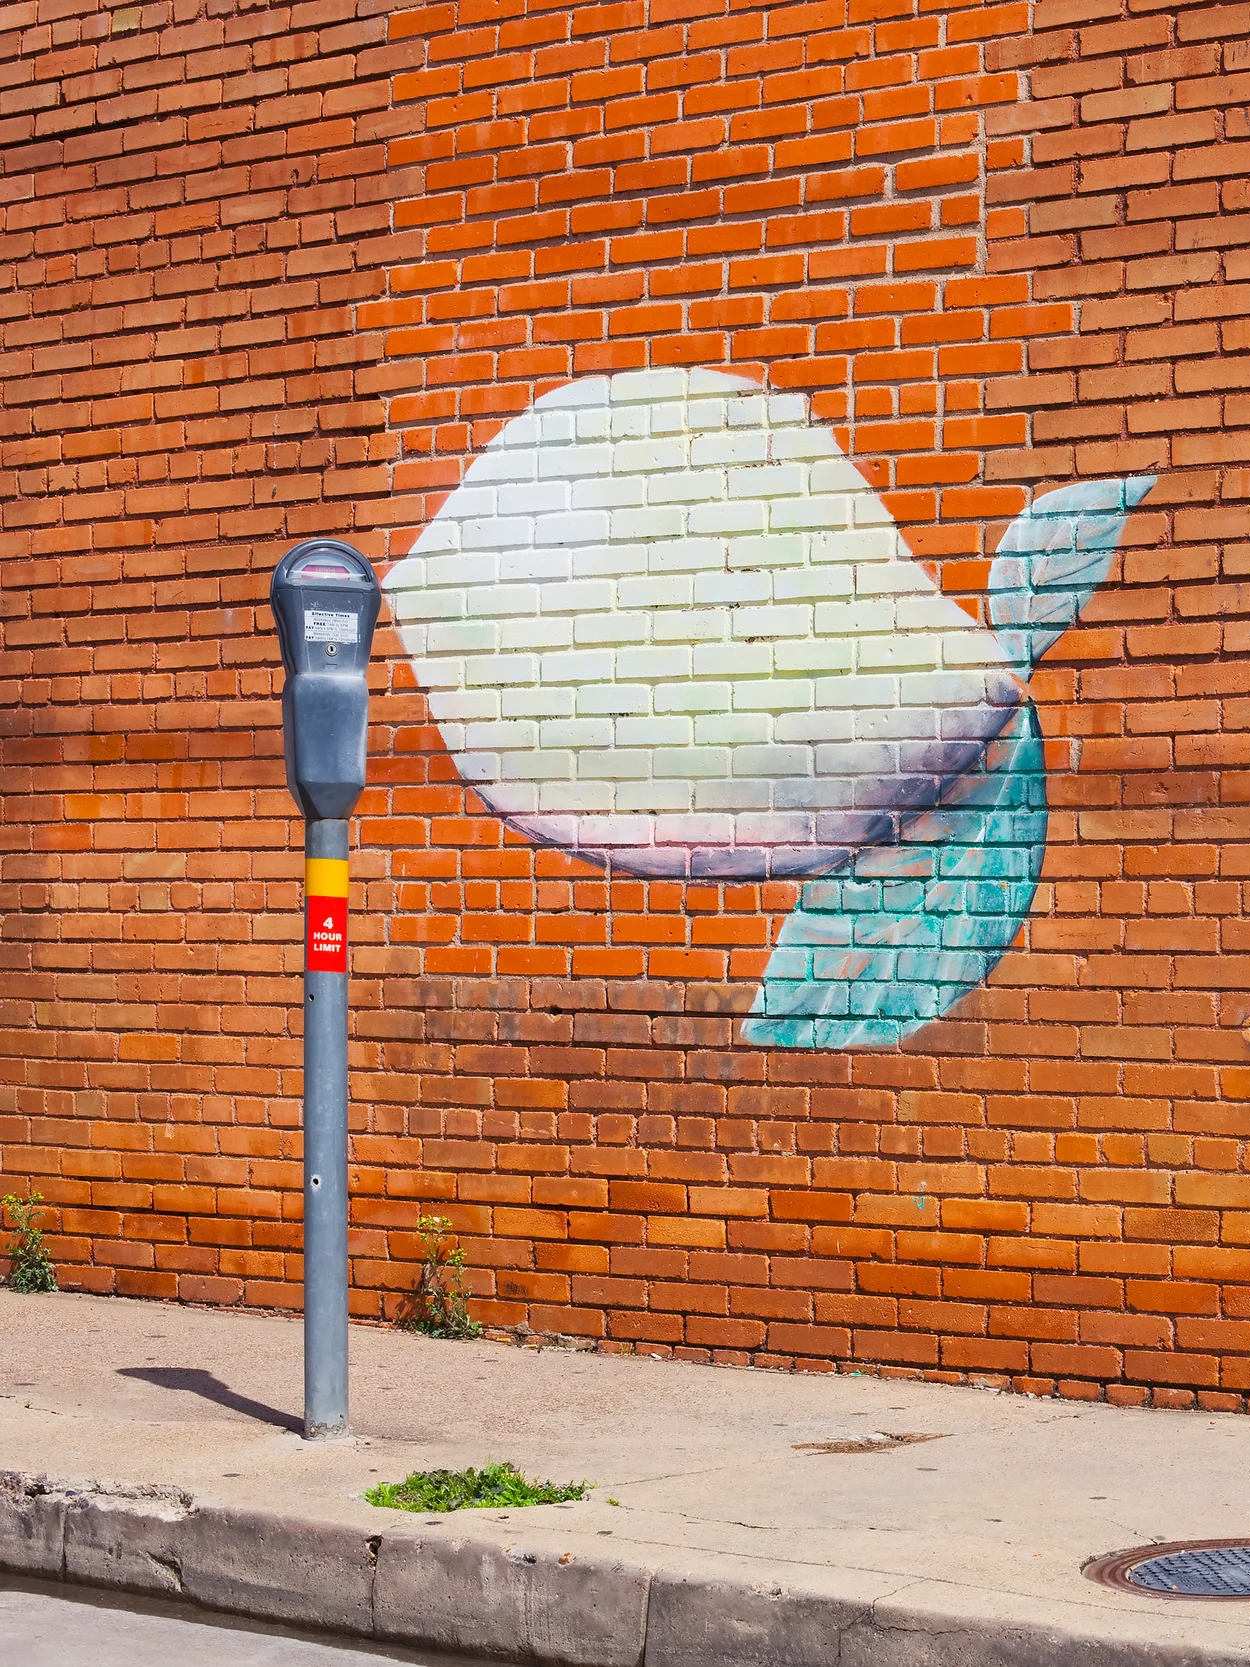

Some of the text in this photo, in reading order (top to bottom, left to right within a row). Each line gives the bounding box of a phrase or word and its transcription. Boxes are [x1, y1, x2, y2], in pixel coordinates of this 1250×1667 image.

[323, 917, 334, 929] 4
[313, 932, 342, 941] HOUR
[313, 943, 341, 952] LIMIT
